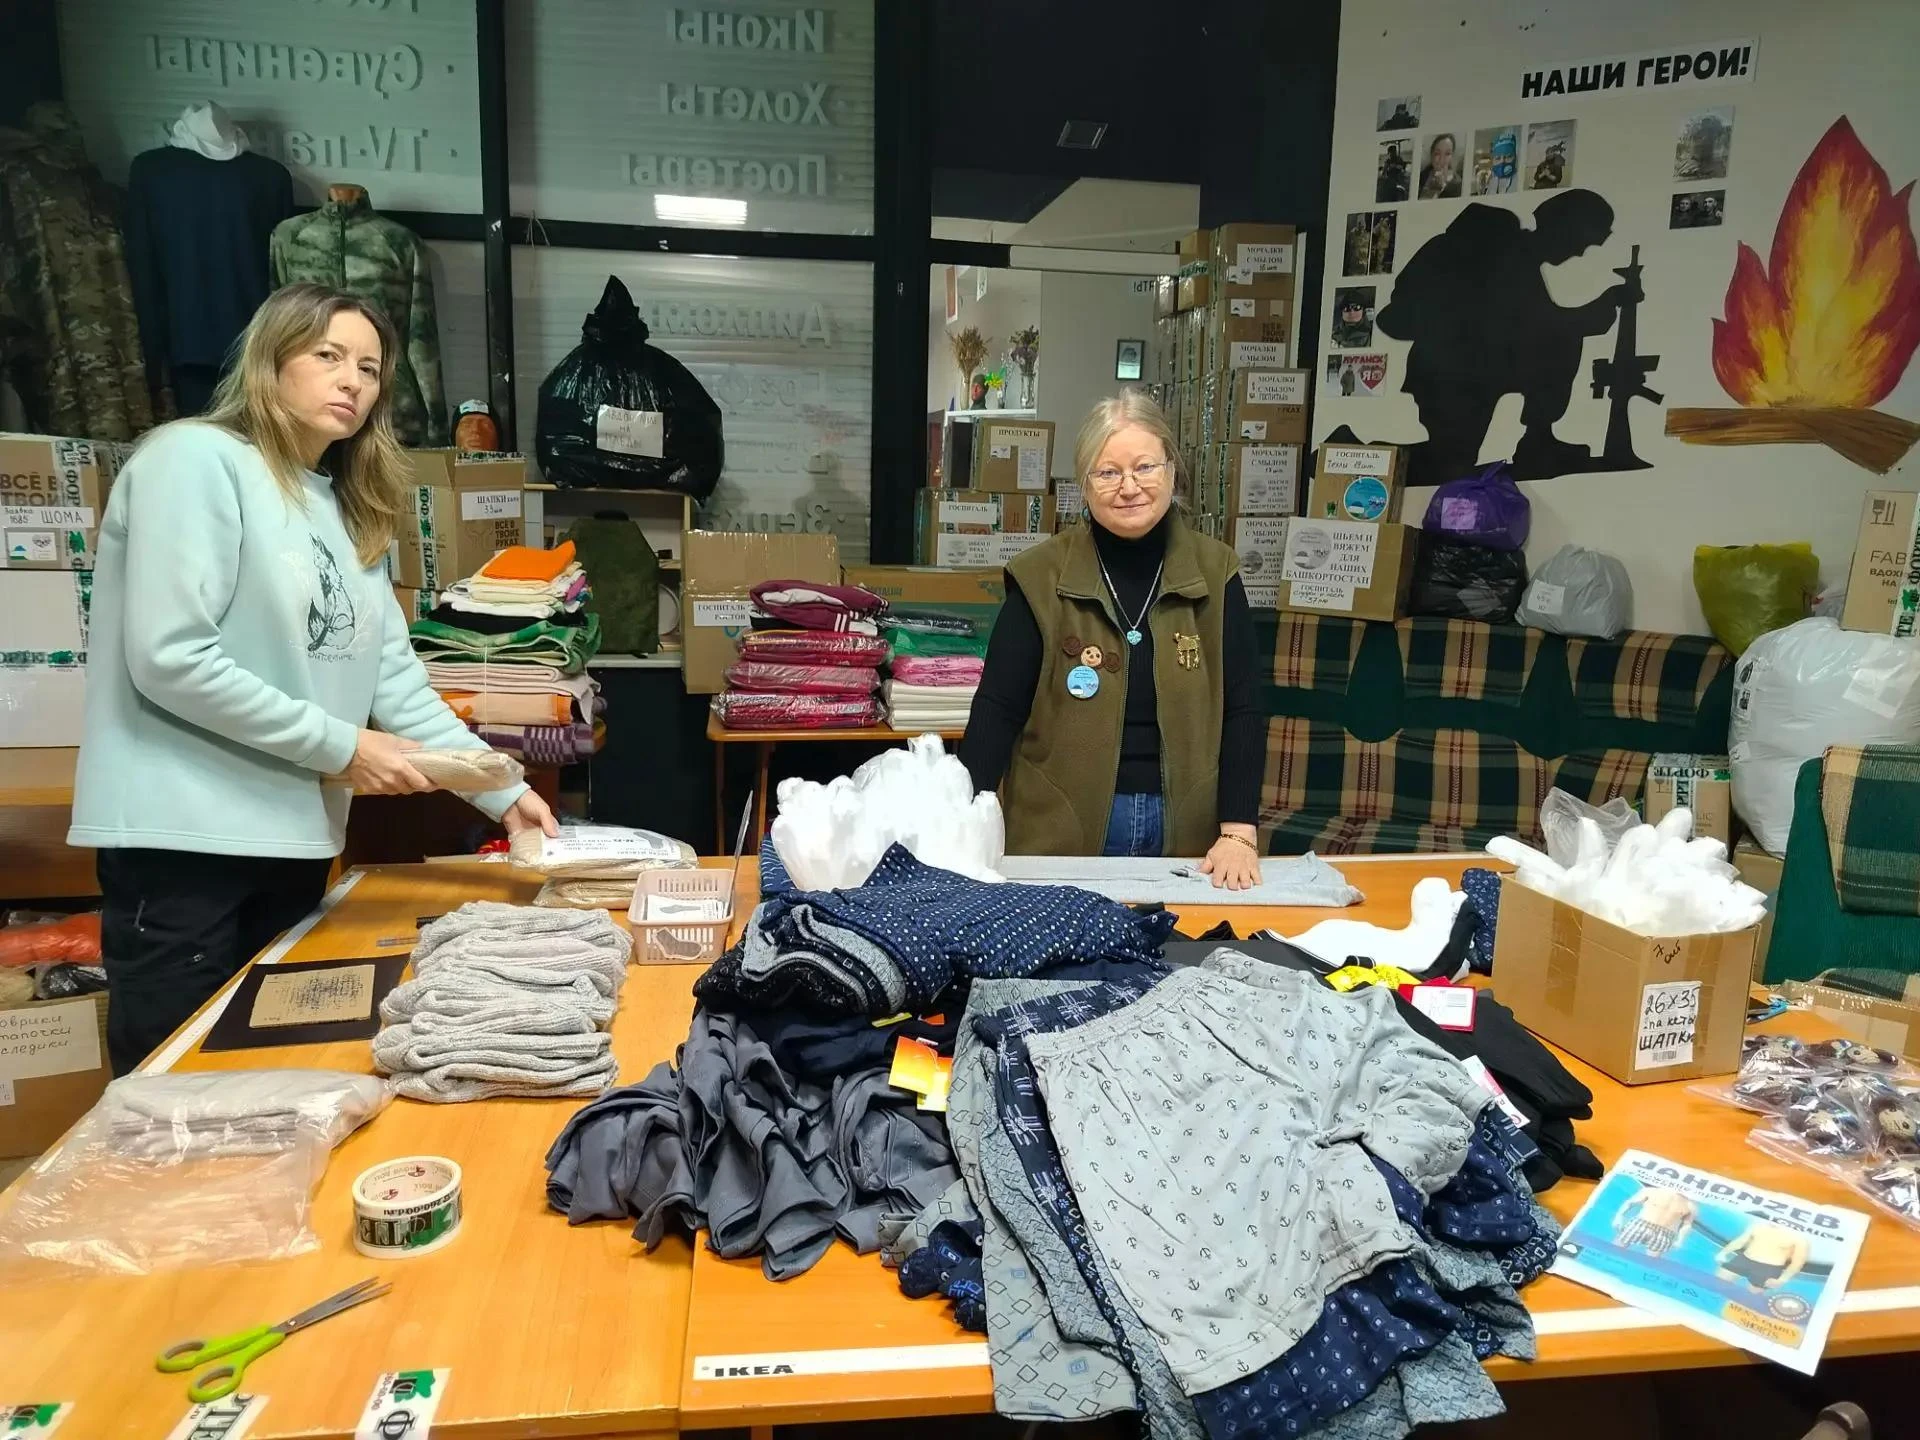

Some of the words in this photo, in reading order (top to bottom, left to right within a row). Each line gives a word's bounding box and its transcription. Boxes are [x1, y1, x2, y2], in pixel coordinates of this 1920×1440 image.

[1521, 62, 1625, 100] НАШИ
[1636, 45, 1752, 89] ГЕРОИ!
[998, 429, 1041, 437] ПРОДУКТЫ
[1336, 451, 1380, 459] ГОСПИТАЛЬ
[477, 495, 506, 505] ШАПКИ
[948, 504, 988, 513] ГОСПИТАЛЬ
[40, 510, 84, 524] ШОМА
[1333, 532, 1362, 541] ШЬЕМ
[1333, 543, 1369, 552] ВЯЖЕМ
[1339, 553, 1360, 562] ДЛЯ
[1869, 550, 1907, 566] FAB
[1330, 563, 1367, 573] НАШИХ
[1869, 567, 1904, 578] ВДОХ
[1286, 570, 1369, 585] БАШКОРТОСТАН
[1881, 579, 1897, 588] НА
[0, 1014, 62, 1031] оврики
[1631, 1159, 1841, 1231] JAHONZEB
[714, 1364, 795, 1378] IKEA
